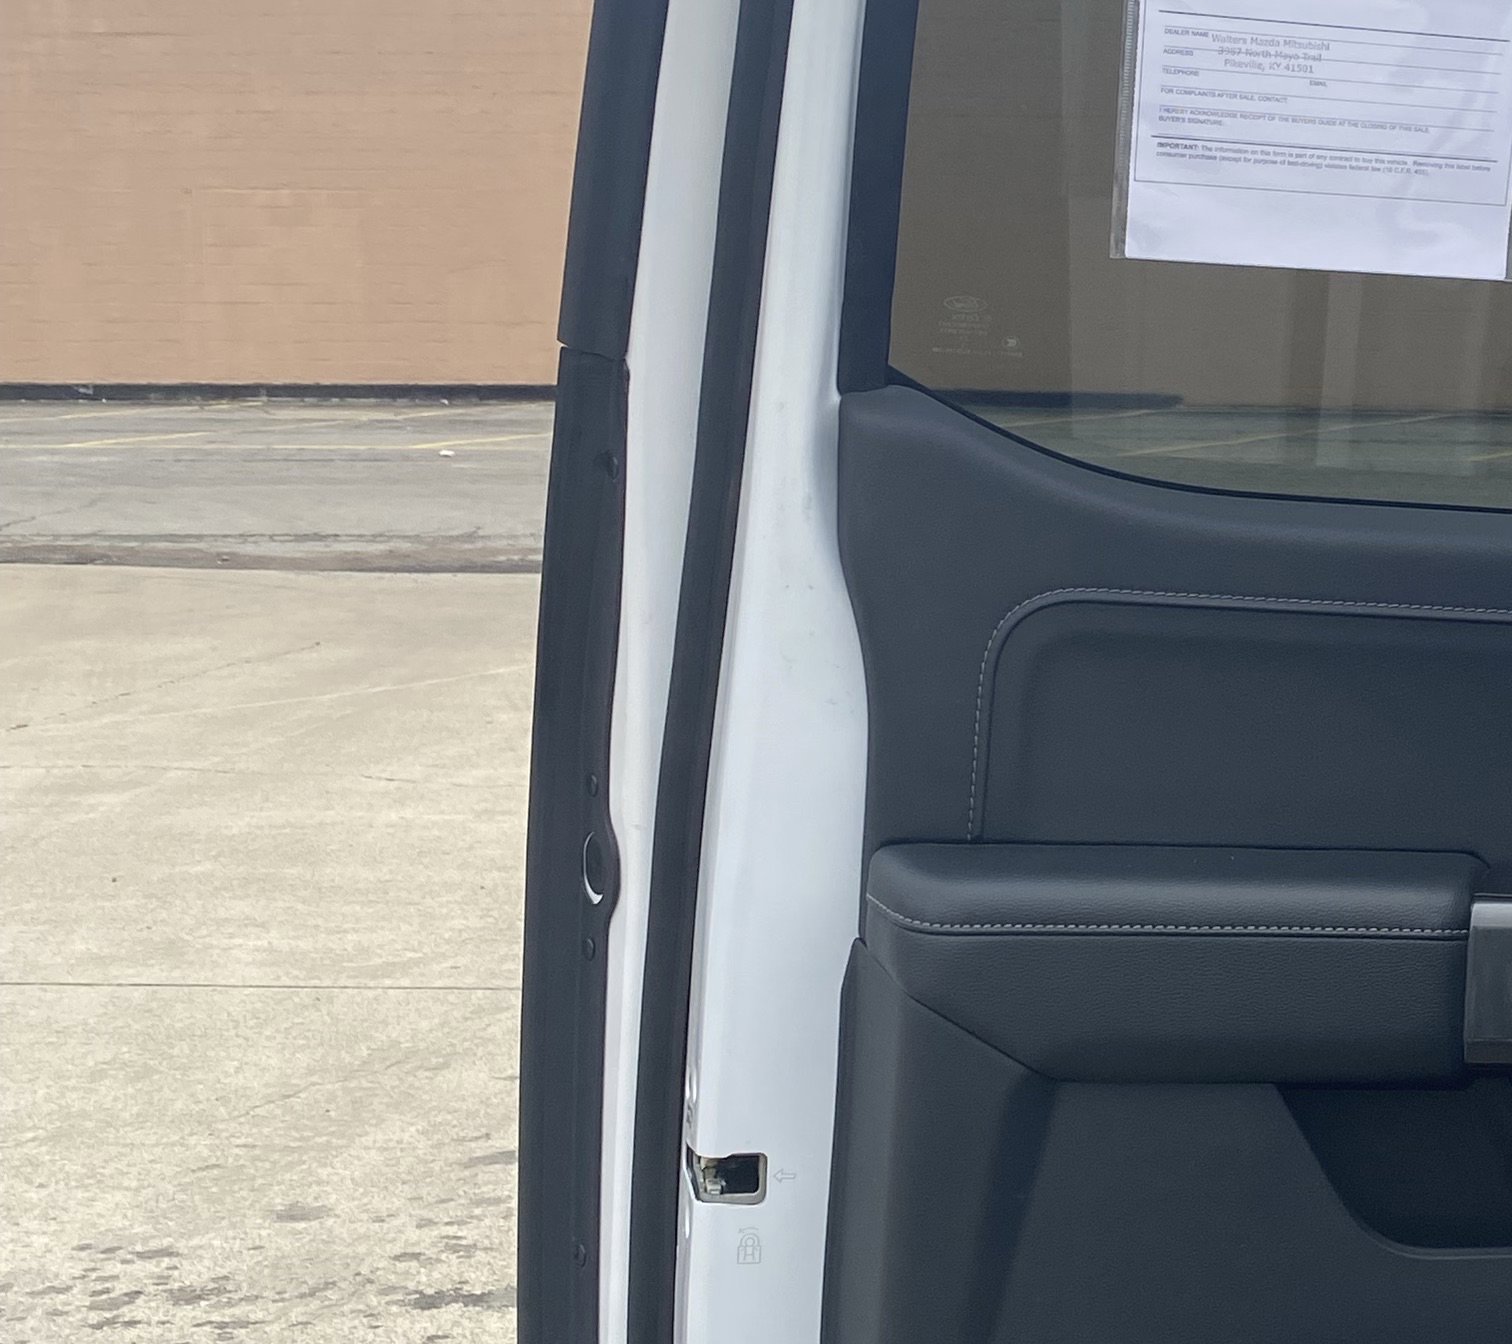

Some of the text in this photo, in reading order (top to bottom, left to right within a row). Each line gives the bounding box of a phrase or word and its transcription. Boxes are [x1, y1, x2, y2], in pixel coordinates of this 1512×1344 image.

[1164, 28, 1189, 36] DEALER
[1210, 33, 1330, 51] Walters Mazda Mitsubishi
[1244, 48, 1272, 59] North
[1274, 50, 1300, 63] Mayo
[1302, 52, 1322, 63] Trail
[1223, 58, 1314, 74] Pikeville, KY 41501
[1175, 89, 1216, 98] COMPLAINTS
